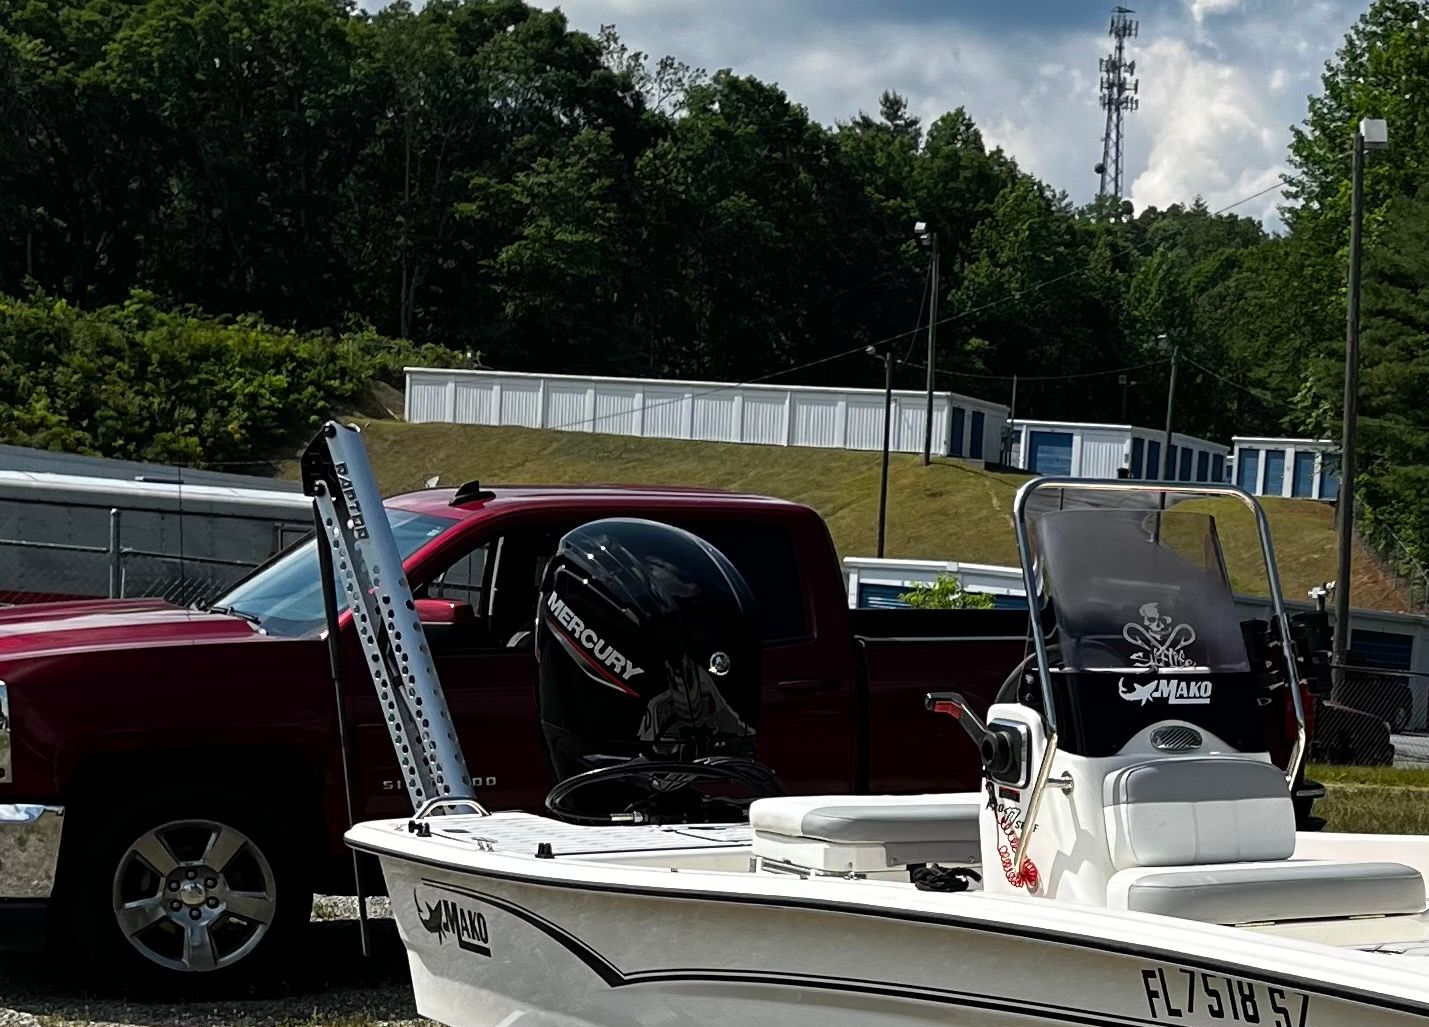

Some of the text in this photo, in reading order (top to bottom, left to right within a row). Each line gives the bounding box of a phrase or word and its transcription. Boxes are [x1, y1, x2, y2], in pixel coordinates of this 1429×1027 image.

[336, 462, 370, 540] RAPTOR
[547, 590, 645, 680] MERCURY
[1151, 679, 1213, 705] MAKO
[442, 899, 492, 958] MAKO
